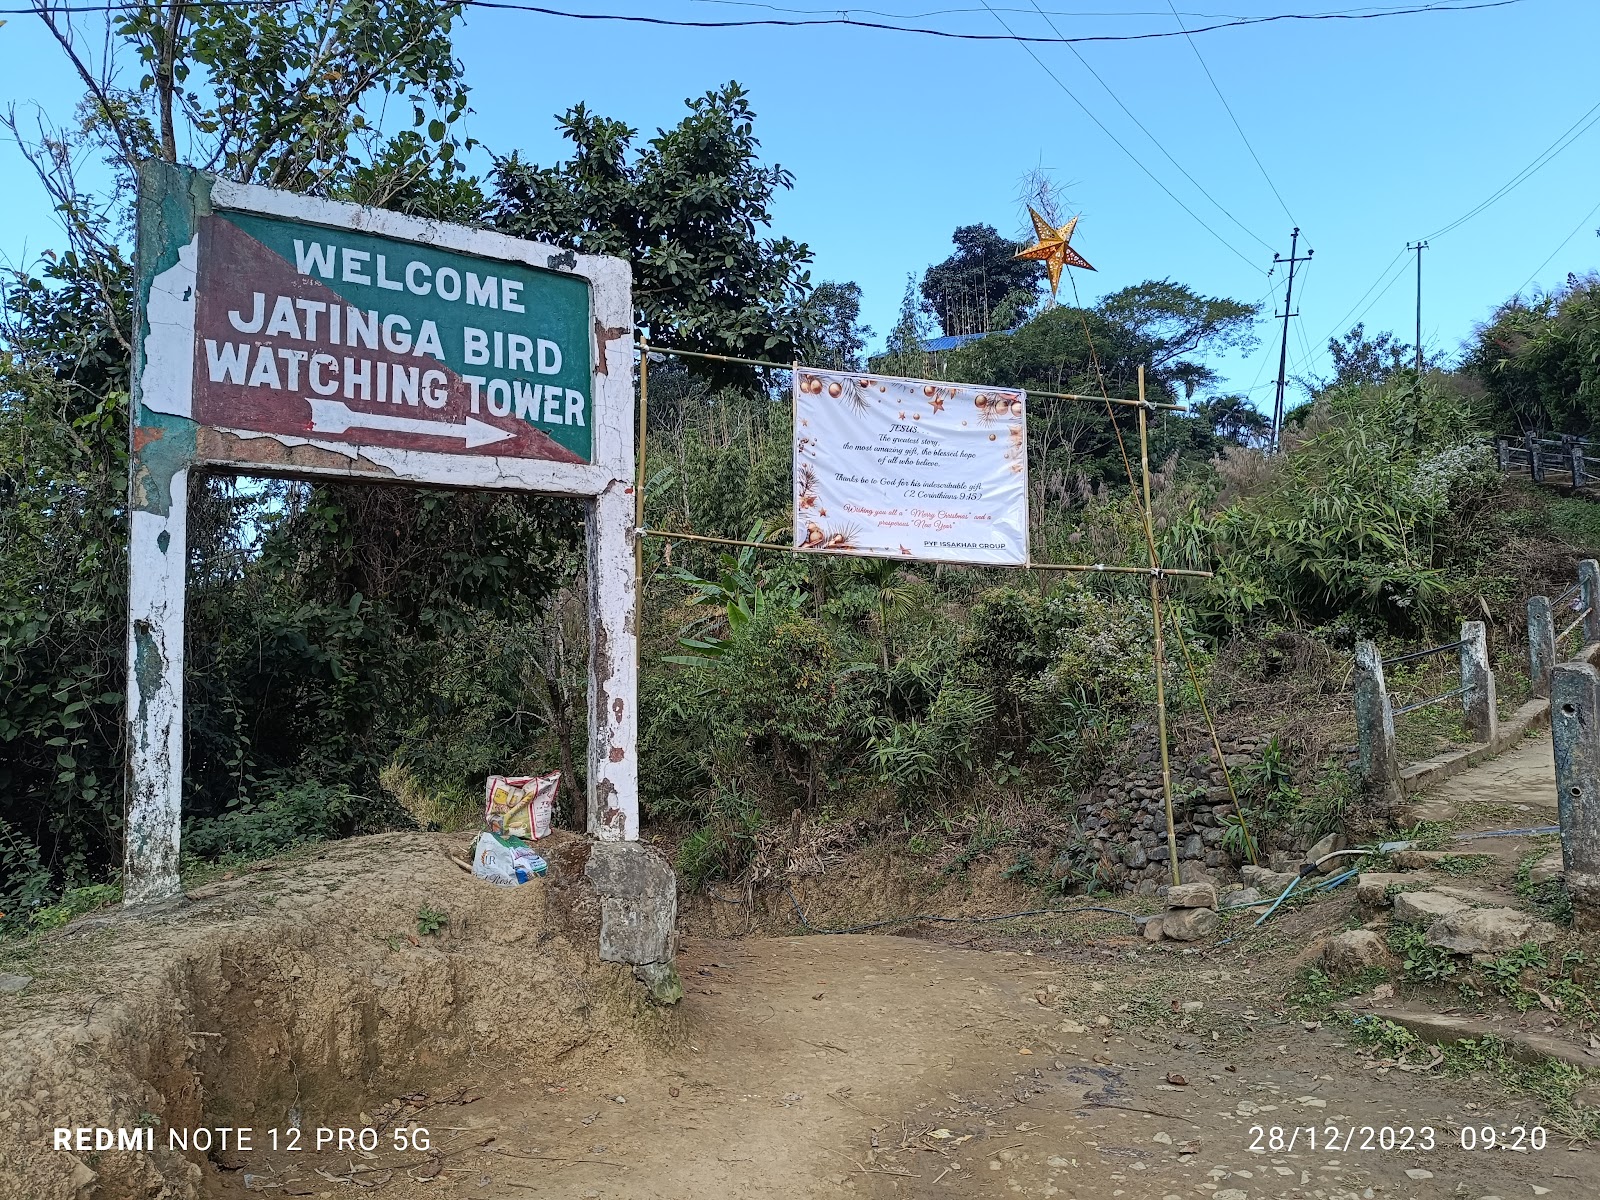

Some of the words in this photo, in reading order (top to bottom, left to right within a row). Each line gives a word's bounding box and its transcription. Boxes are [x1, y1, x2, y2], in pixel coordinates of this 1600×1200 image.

[293, 239, 526, 314] WELCOME
[227, 292, 446, 361] JATINGA
[463, 326, 563, 376] BIRD
[204, 339, 448, 409] WATCHING
[462, 374, 586, 427] TOWER
[878, 433, 891, 442] The
[892, 436, 919, 444] greatest
[920, 438, 940, 447] story,
[842, 442, 853, 450] the
[854, 444, 872, 452] most
[873, 446, 903, 455] amazing
[921, 448, 932, 456] the
[933, 449, 958, 458] blessed
[959, 450, 976, 460] hope
[877, 456, 887, 465] of
[887, 456, 898, 464] all
[898, 457, 914, 465] who
[834, 472, 859, 483] Thanks
[860, 475, 869, 484] be
[870, 476, 878, 484] to
[879, 477, 897, 486] God
[896, 477, 909, 488] for
[910, 478, 921, 487] his
[922, 480, 967, 490] indescribable
[917, 490, 958, 500] Corinthians
[843, 503, 873, 516] Wishing
[873, 508, 887, 517] you
[888, 508, 898, 516] all
[877, 519, 909, 528] prosperous
